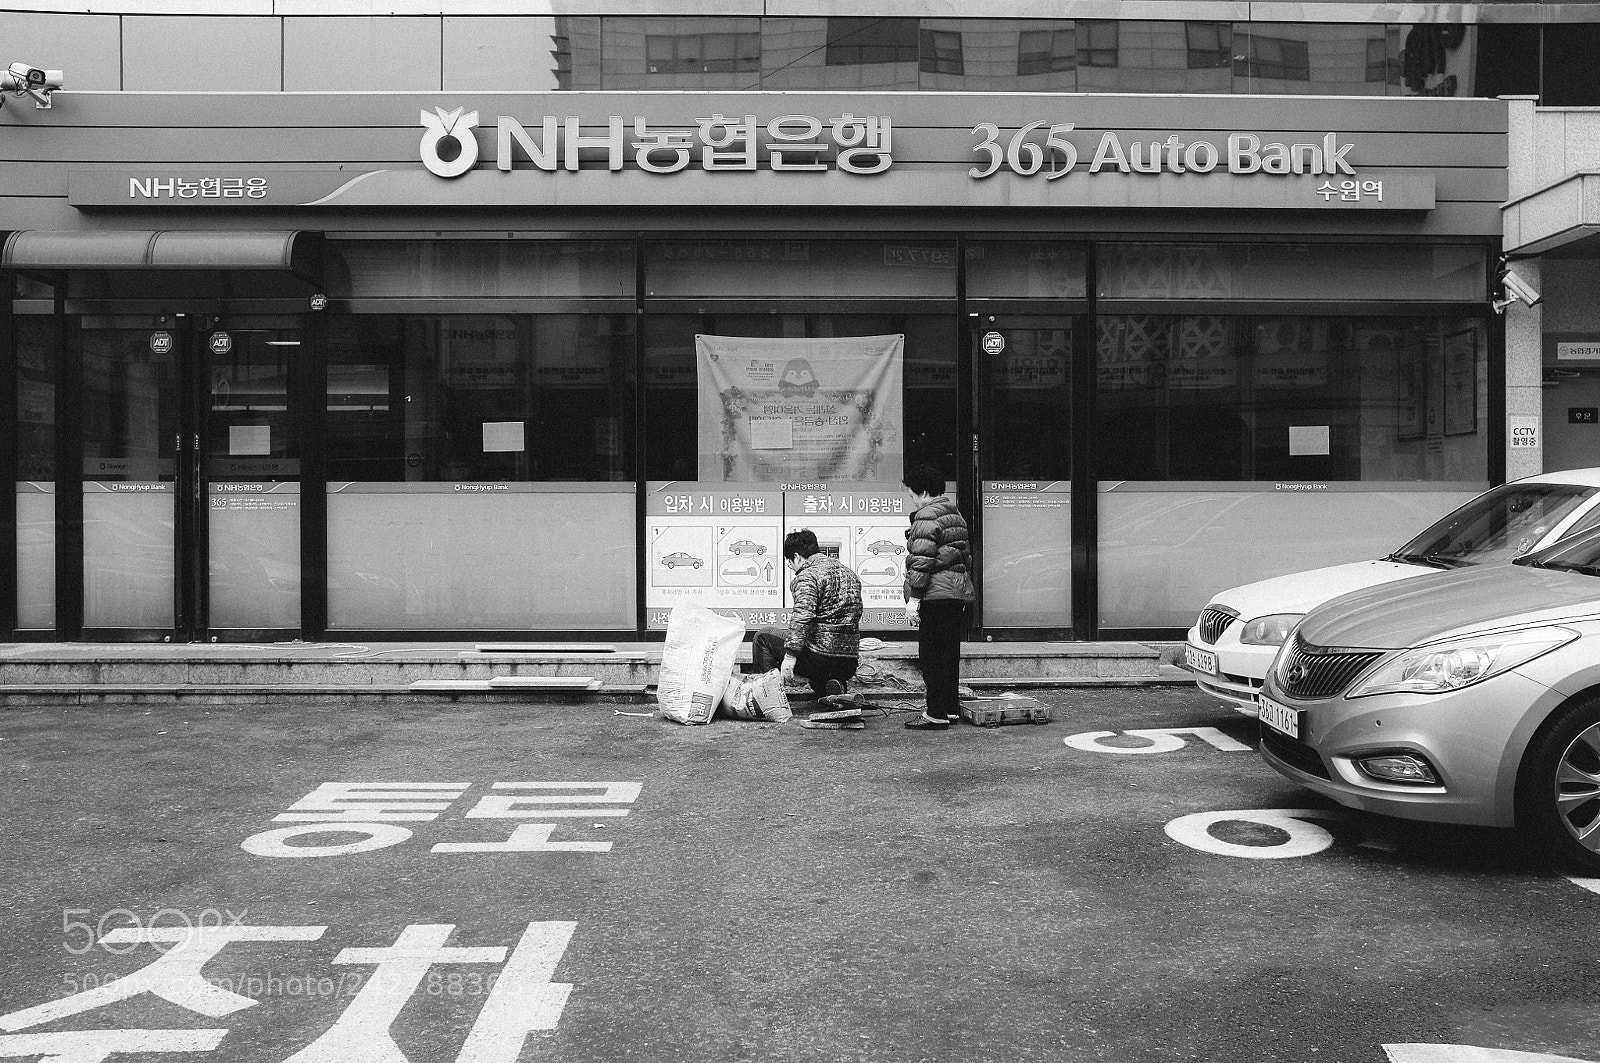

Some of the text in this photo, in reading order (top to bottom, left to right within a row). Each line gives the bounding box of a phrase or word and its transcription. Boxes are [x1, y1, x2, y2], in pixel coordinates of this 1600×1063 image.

[497, 113, 892, 175] NH농협은행
[968, 120, 1356, 181] 365 Auto Bank
[128, 177, 268, 199] NH농협금융
[1316, 180, 1384, 202] 수원역
[311, 298, 324, 306] ADT
[153, 338, 169, 347] ADT
[213, 338, 229, 347] ADT
[986, 338, 1001, 348] ADT
[1513, 427, 1536, 436] CCTV
[1512, 437, 1537, 446] 촬영중
[119, 484, 150, 492] NongHyup
[461, 484, 493, 492] NongHyup
[1282, 483, 1312, 491] NongHyup
[211, 497, 227, 507] 365
[664, 495, 765, 513] 입차 시 이용방법
[803, 495, 903, 514] 출차 시 이용방법
[984, 495, 1000, 505] 365
[720, 527, 726, 535] 2
[858, 527, 864, 535] 2
[749, 611, 777, 625] 정산후
[1276, 707, 1294, 734] 1161
[241, 782, 643, 859] 통로
